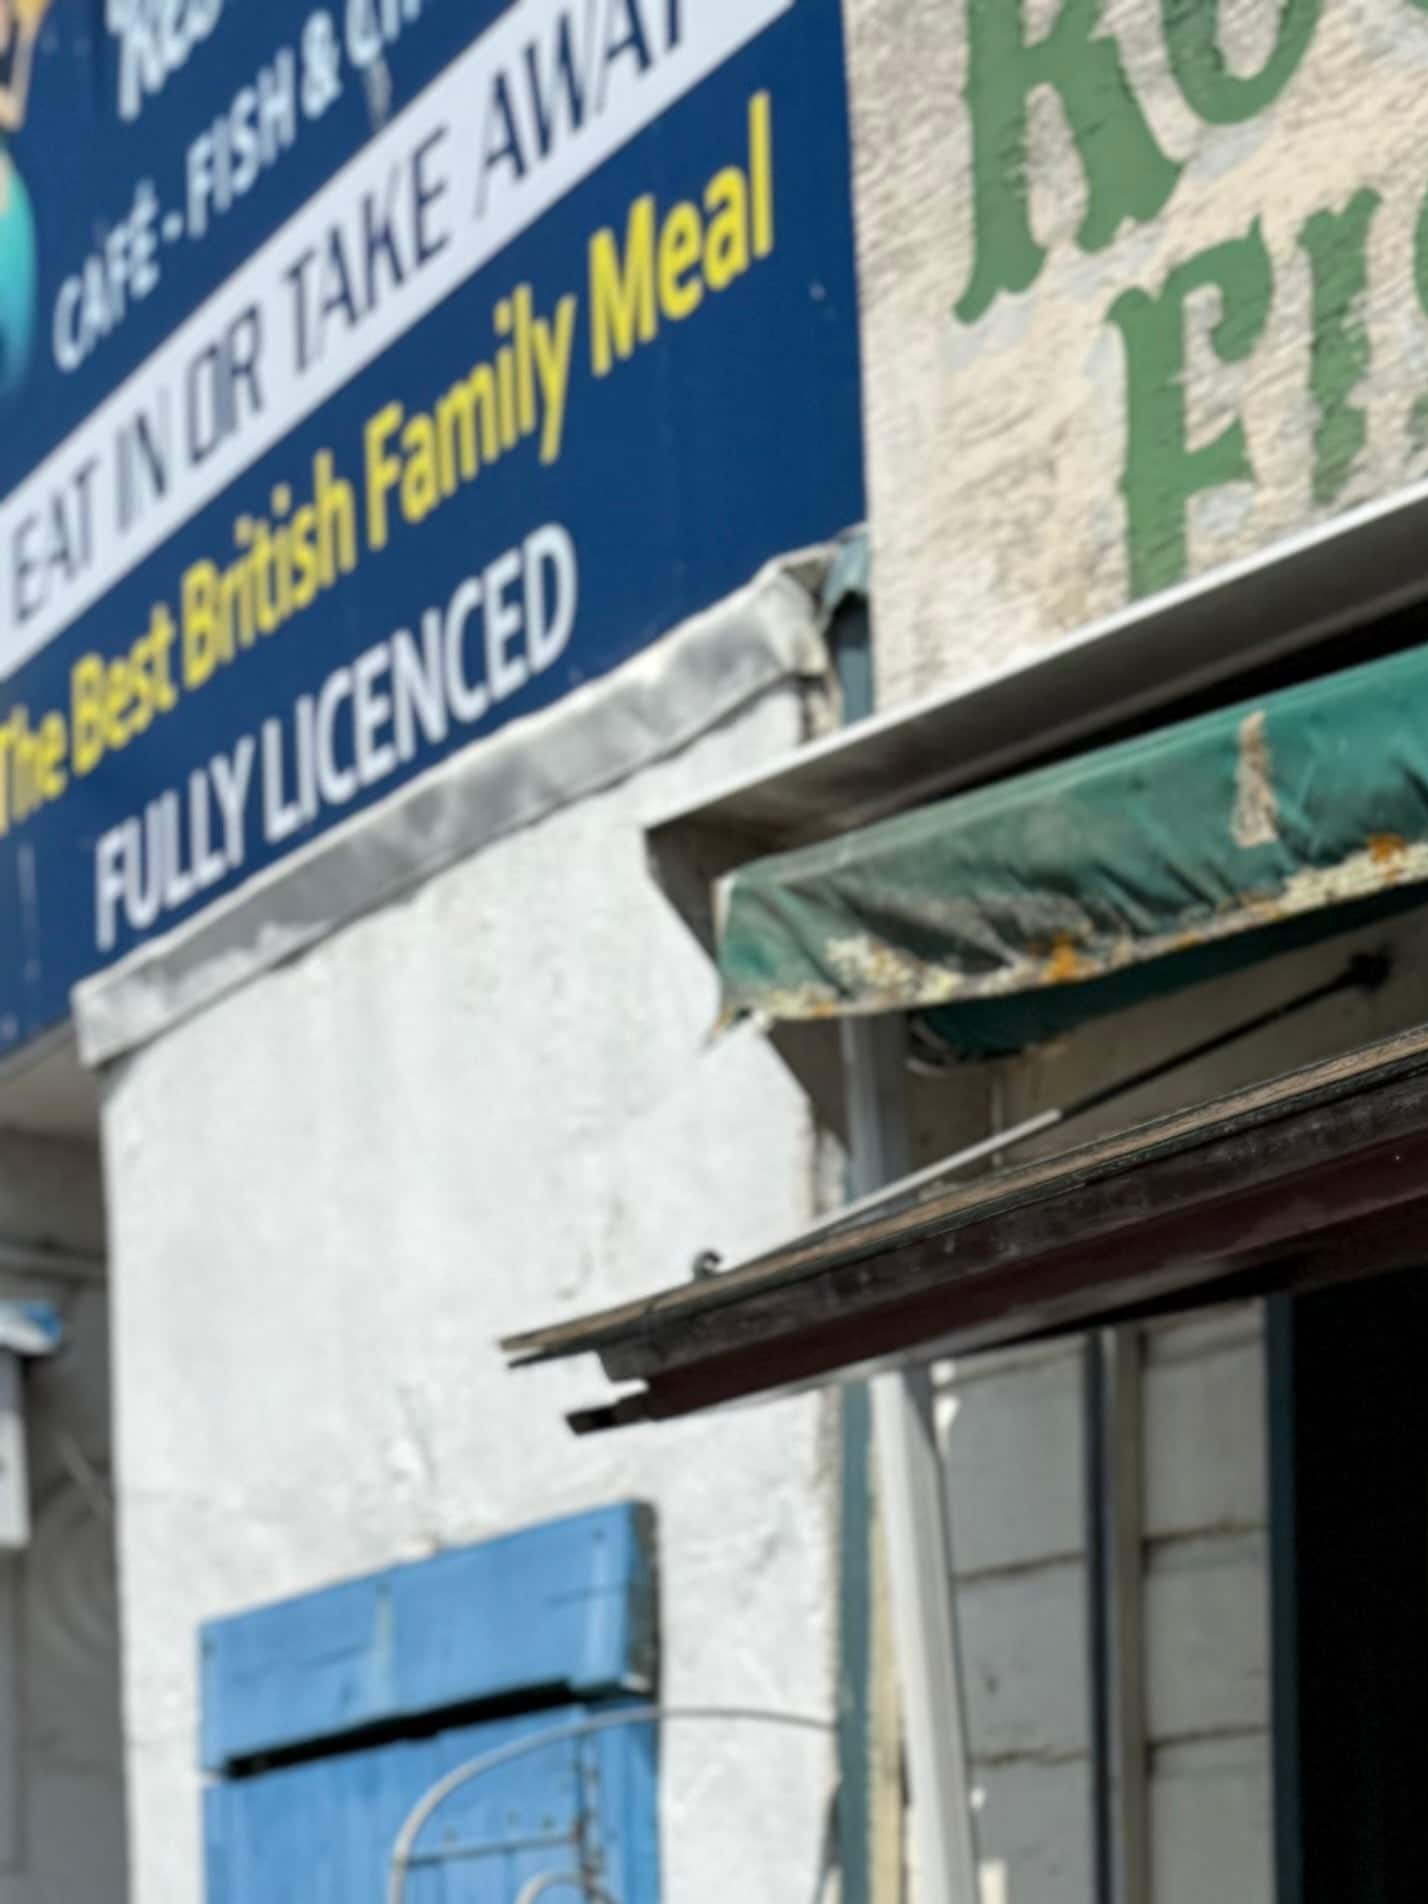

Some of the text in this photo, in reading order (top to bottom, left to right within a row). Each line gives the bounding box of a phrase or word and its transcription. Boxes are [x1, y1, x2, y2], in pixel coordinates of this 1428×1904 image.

[187, 45, 295, 238] FISH
[302, 10, 341, 119] &
[12, 456, 98, 628] EAT
[116, 386, 170, 536] IN
[185, 302, 262, 468] OR
[283, 123, 453, 374] TAKE
[71, 601, 177, 776] Best
[182, 468, 357, 690] British
[364, 282, 575, 553] Family
[588, 88, 773, 377] Meal
[96, 521, 578, 950] FULLY LICENCED
